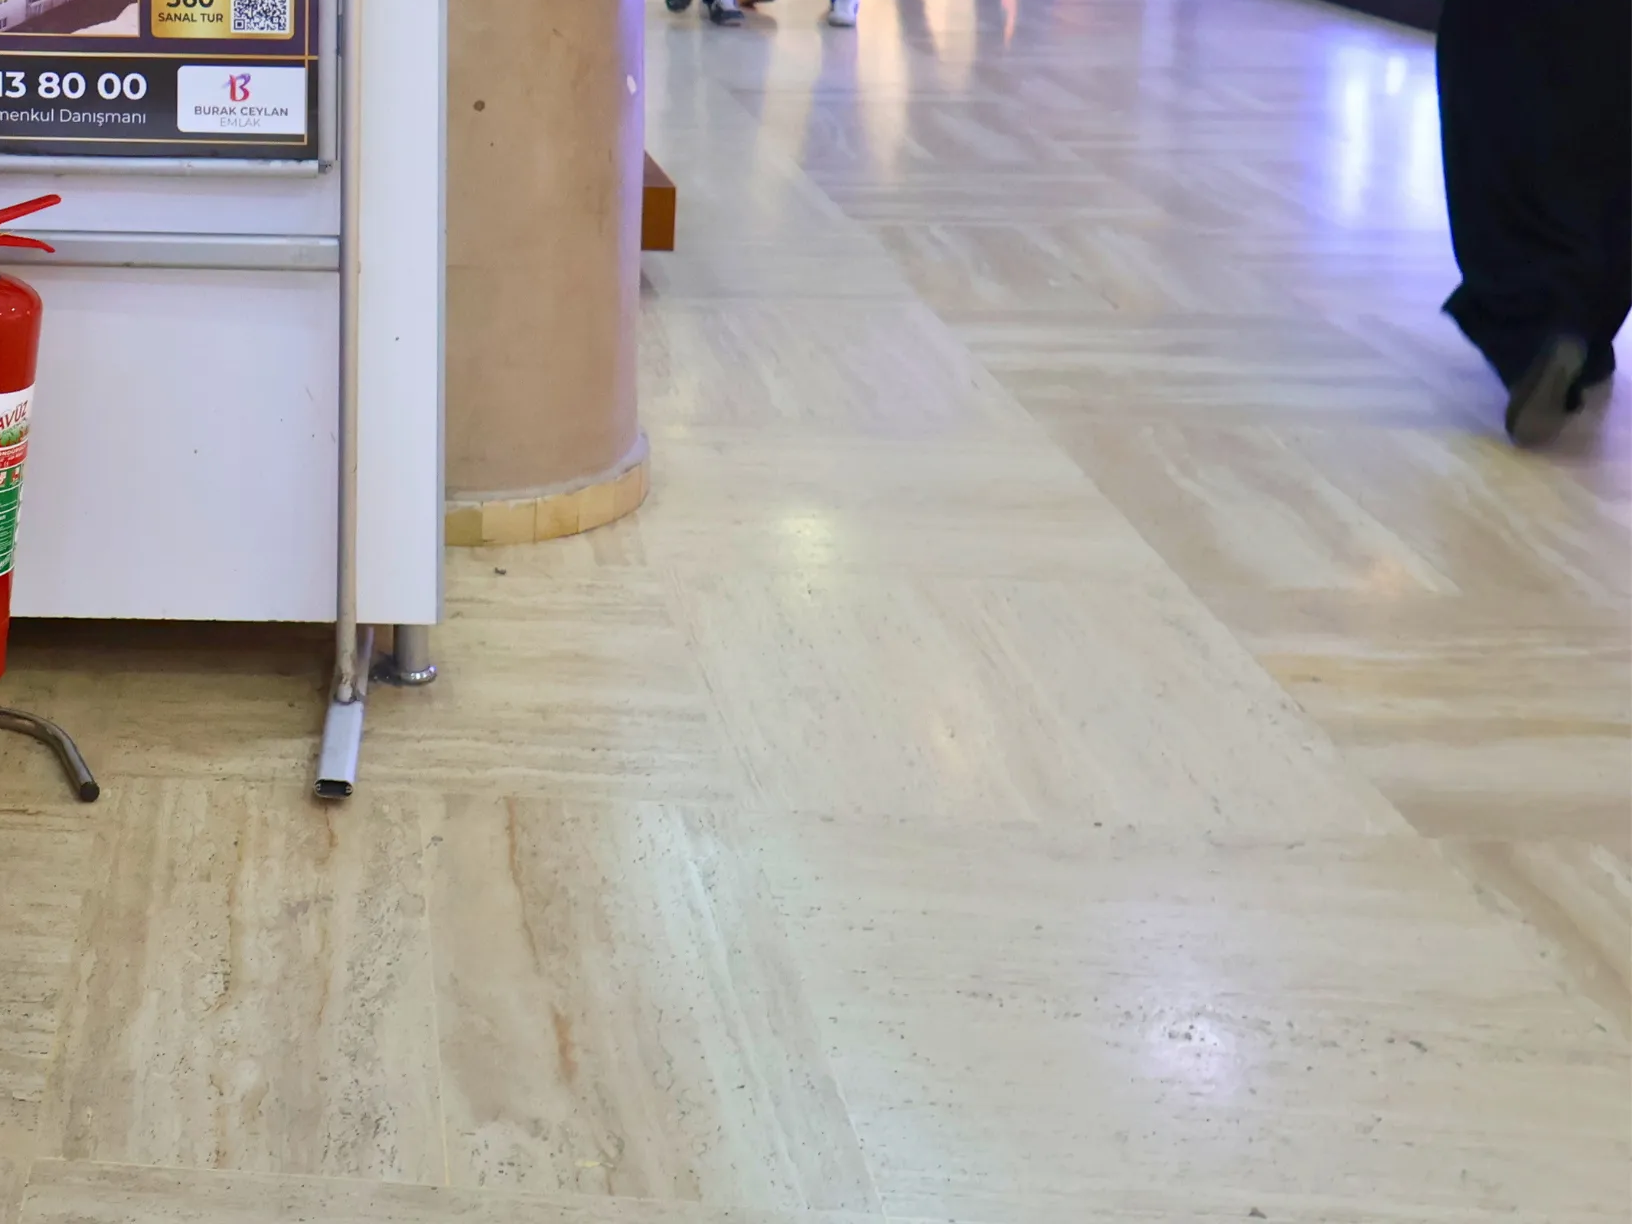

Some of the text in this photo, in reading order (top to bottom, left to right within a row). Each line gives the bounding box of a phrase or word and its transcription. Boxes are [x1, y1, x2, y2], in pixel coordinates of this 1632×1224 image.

[158, 12, 224, 23] SANAL TUR
[37, 72, 86, 99] 80
[97, 72, 147, 100] 00
[194, 105, 288, 117] BURAK CEYLAN
[59, 109, 146, 127] Danışmanı
[220, 117, 261, 128] EMLAK
